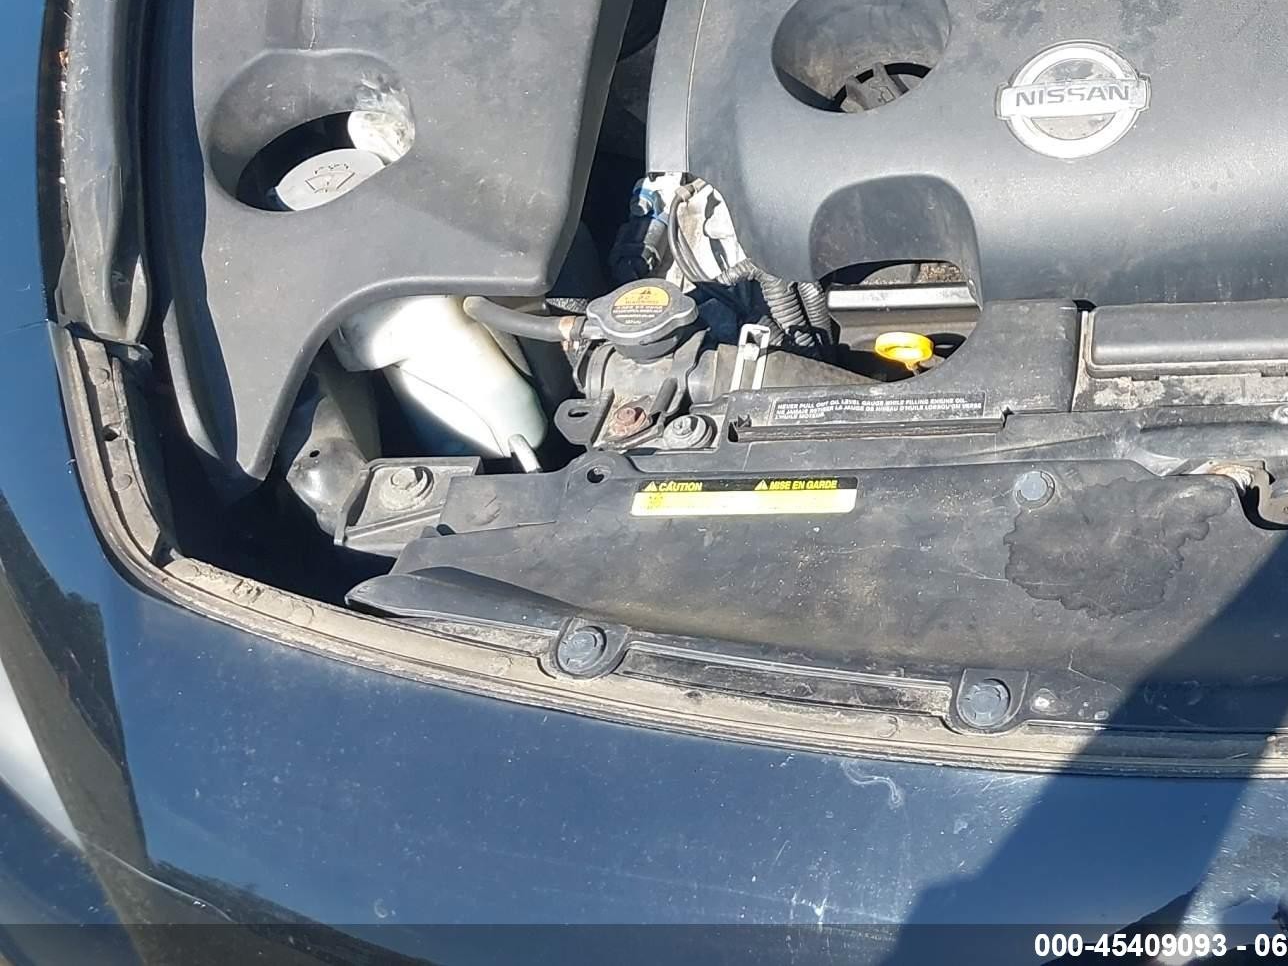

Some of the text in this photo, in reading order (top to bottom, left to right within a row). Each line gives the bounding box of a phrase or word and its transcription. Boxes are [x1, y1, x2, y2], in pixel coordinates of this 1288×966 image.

[1015, 85, 1130, 107] NISSAN
[658, 479, 838, 491] CAUTION MISE EN GARDE
